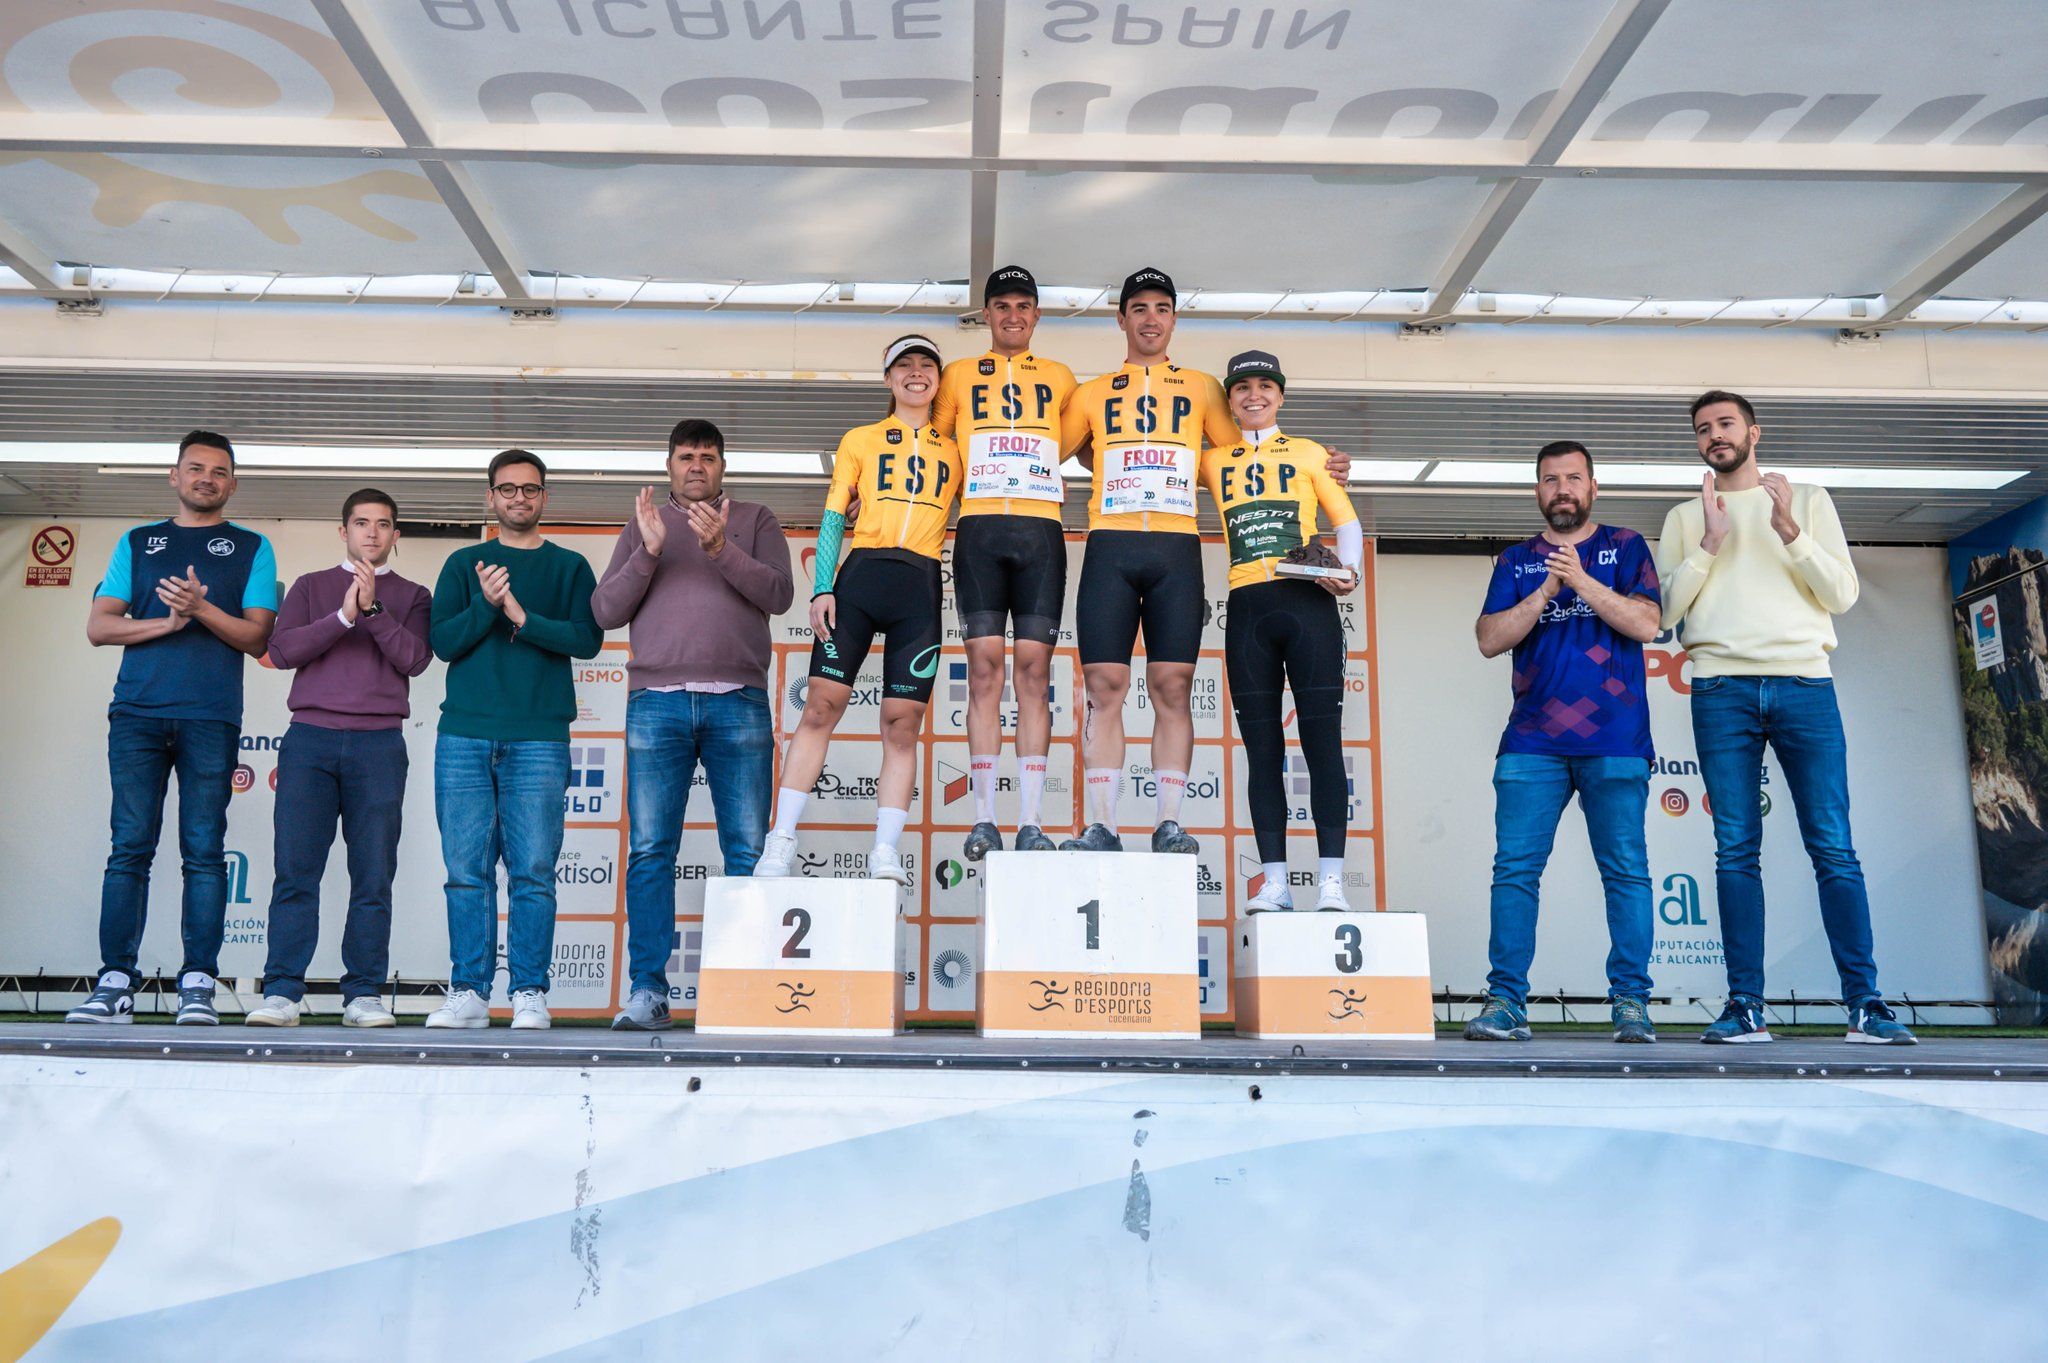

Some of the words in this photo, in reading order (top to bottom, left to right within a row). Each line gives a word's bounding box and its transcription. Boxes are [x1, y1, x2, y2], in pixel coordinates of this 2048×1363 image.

[1232, 361, 1274, 371] NESTA
[1163, 377, 1185, 385] GOBIK
[971, 382, 1053, 421] ESP
[1104, 394, 1192, 436] ESP
[989, 435, 1041, 454] FROIZ
[1123, 449, 1177, 466] FROIZ
[877, 453, 950, 498] ESP
[1029, 464, 1051, 477] BH
[1165, 476, 1189, 488] BH
[1221, 462, 1296, 503] ESP
[1229, 509, 1294, 528] NESTA
[1237, 522, 1284, 537] MMR
[148, 536, 168, 544] ITC
[1598, 548, 1618, 565] CX
[781, 907, 812, 959] 2
[1077, 899, 1101, 950] 1
[1334, 923, 1363, 974] 3
[1655, 937, 1725, 951] IPUTACIÓN
[1668, 954, 1727, 965] ALICANTE
